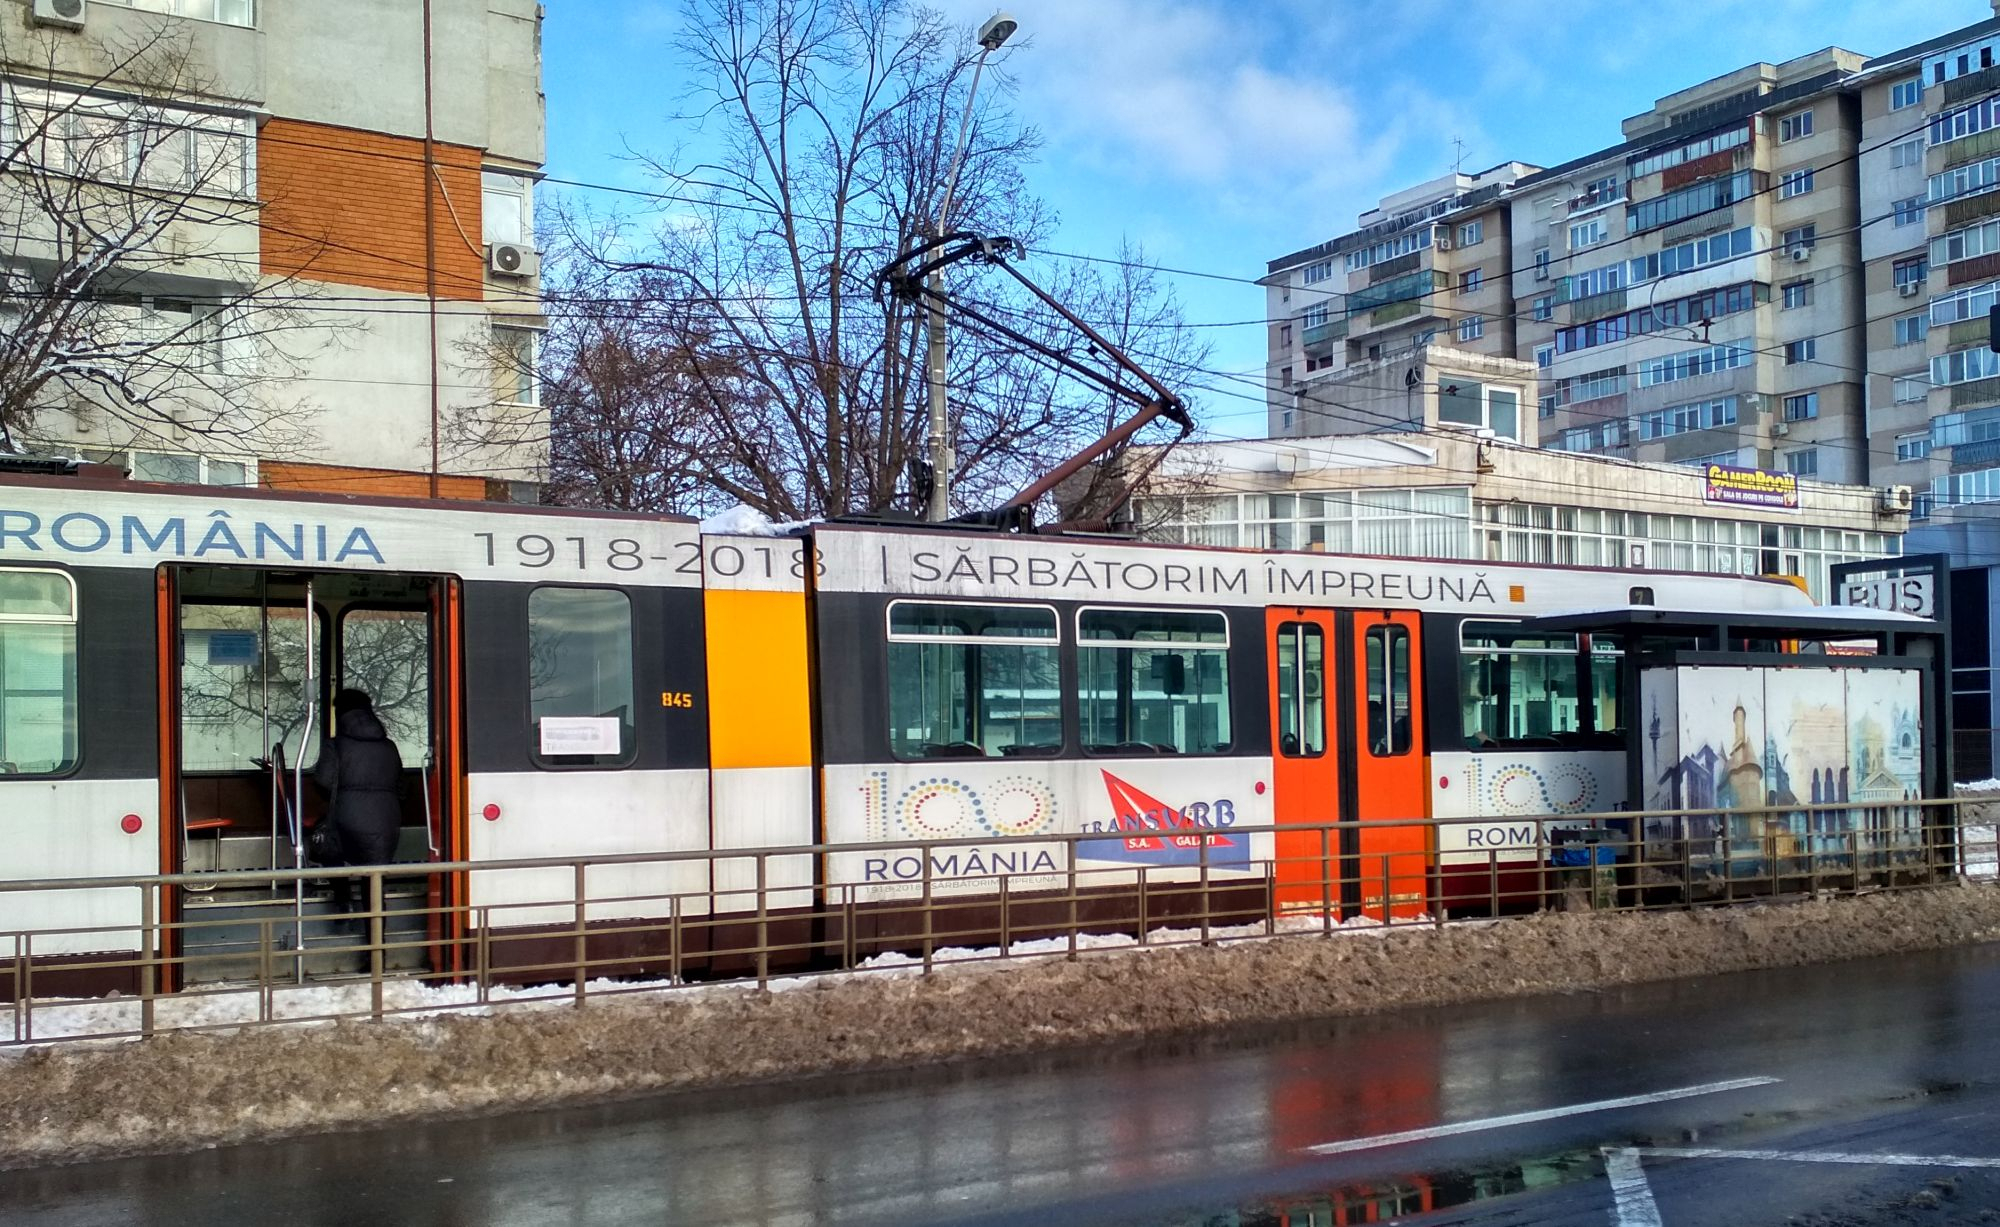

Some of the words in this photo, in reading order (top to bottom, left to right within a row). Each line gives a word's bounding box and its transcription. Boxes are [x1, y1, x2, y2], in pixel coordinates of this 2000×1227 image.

[0, 509, 386, 564] ROMÂNIA
[474, 532, 827, 579] 1918-2018
[911, 546, 1248, 595] SĂRBĂTORIM
[1267, 559, 1497, 604] ÎMPREUNĂ
[1849, 580, 1924, 613] BUS
[661, 692, 693, 708] 845
[1128, 837, 1151, 849] S.A.
[1176, 835, 1215, 847] GALTI
[864, 848, 1057, 881] ROMÂNIA
